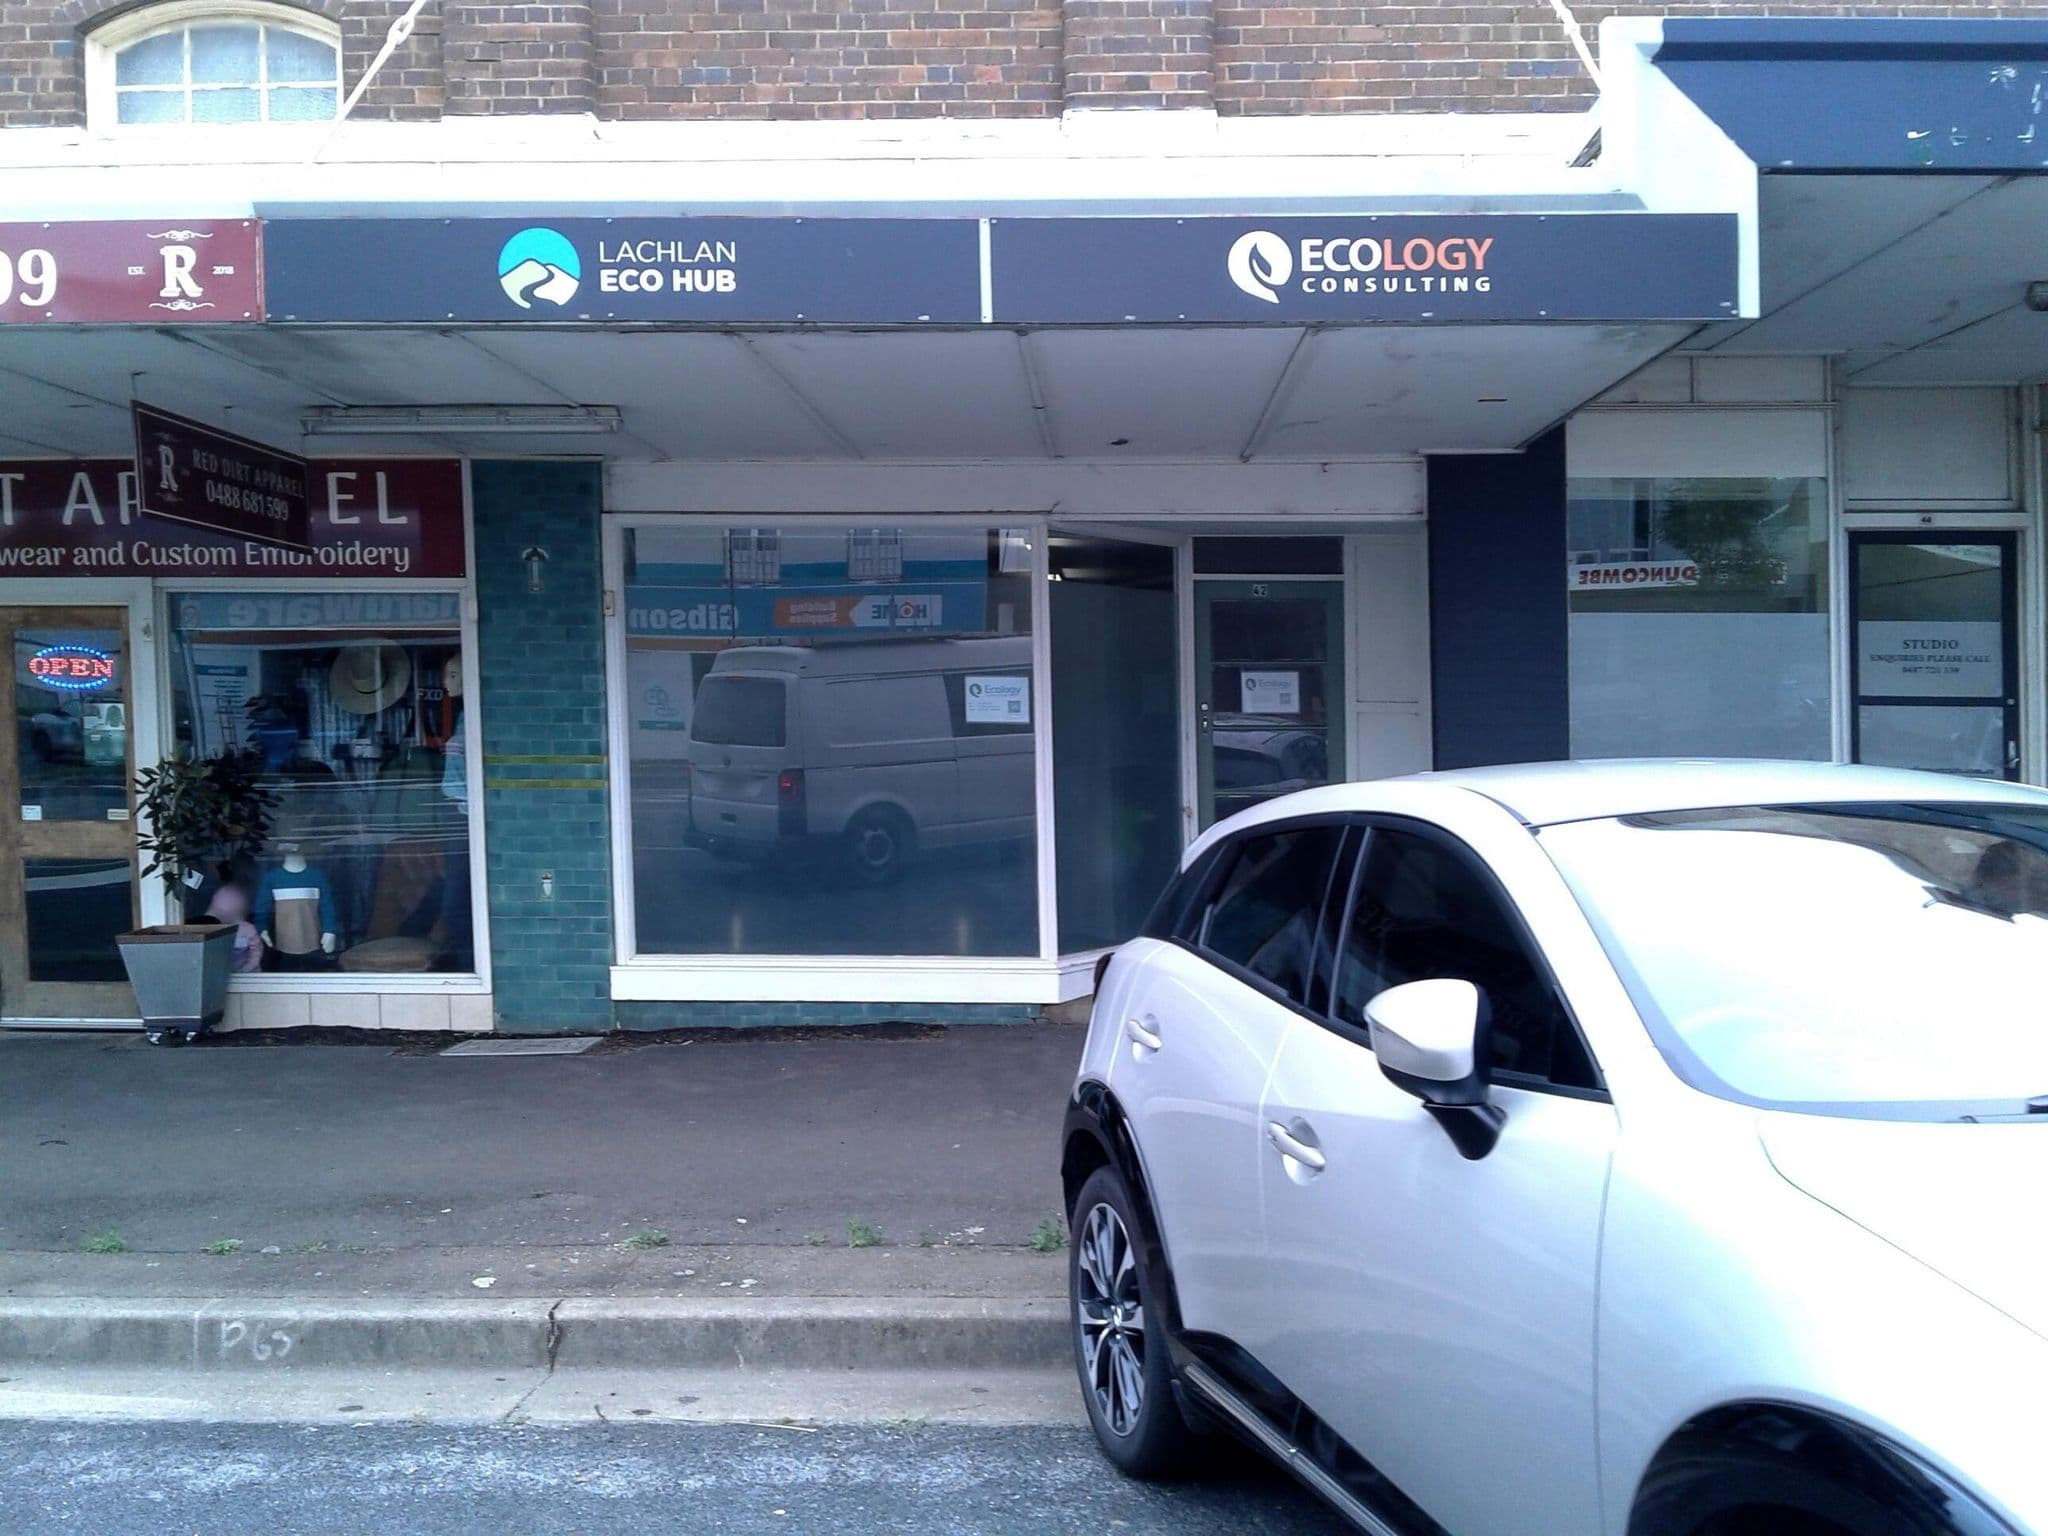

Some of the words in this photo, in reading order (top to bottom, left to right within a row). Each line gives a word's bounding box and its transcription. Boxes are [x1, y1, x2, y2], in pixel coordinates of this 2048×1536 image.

[598, 241, 737, 263] LACHLAN
[1300, 237, 1493, 272] ECOLOGY
[159, 245, 204, 298] R
[599, 268, 664, 292] ECO
[672, 268, 737, 292] HUB
[1302, 276, 1491, 293] CONSULTING
[193, 448, 218, 475] RED
[253, 468, 304, 499] APPAREL
[206, 479, 241, 510] 0488
[242, 490, 267, 516] 681
[268, 495, 289, 521] 599
[73, 541, 126, 566] and
[132, 541, 237, 566] Custom
[244, 540, 410, 573] Embroidery
[1903, 639, 1960, 650] STUDIO
[29, 657, 114, 677] OPEN
